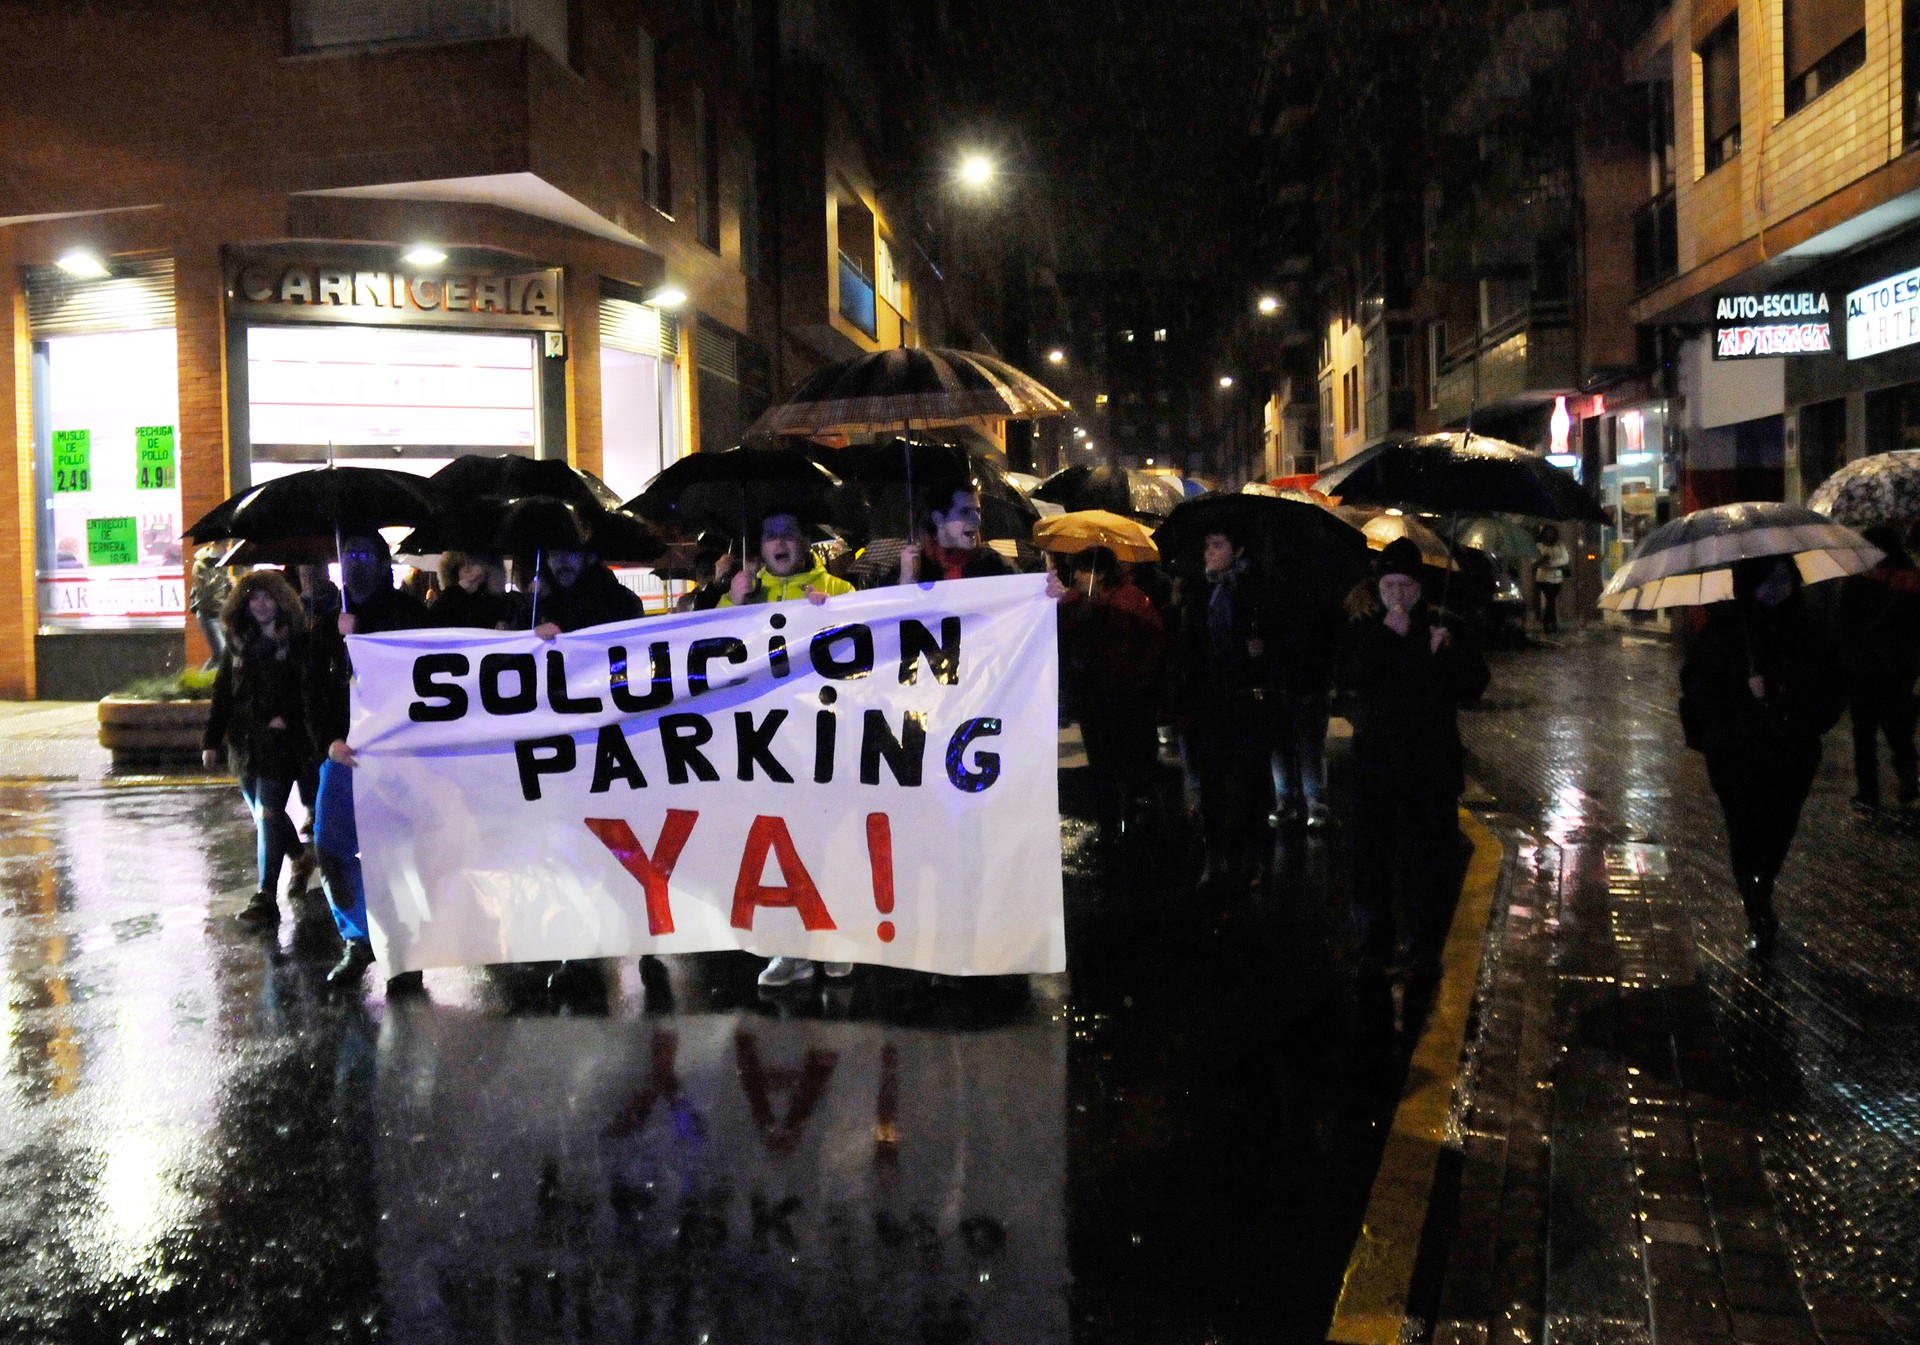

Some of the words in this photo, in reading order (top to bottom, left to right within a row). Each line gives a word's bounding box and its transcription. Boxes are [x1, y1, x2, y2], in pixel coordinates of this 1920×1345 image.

[245, 262, 555, 316] CARNICERIA
[1894, 276, 1920, 304] ES
[1716, 292, 1830, 320] AUTO-ESCUELA
[57, 430, 85, 442] MUSLO
[135, 425, 173, 437] PECHUGA
[66, 442, 77, 453] DE
[147, 438, 159, 449] DE
[58, 454, 85, 465] POLLO
[142, 450, 169, 461] POLLO
[57, 469, 88, 493] 2,49
[101, 530, 112, 541] DE
[583, 807, 896, 944] YA!
